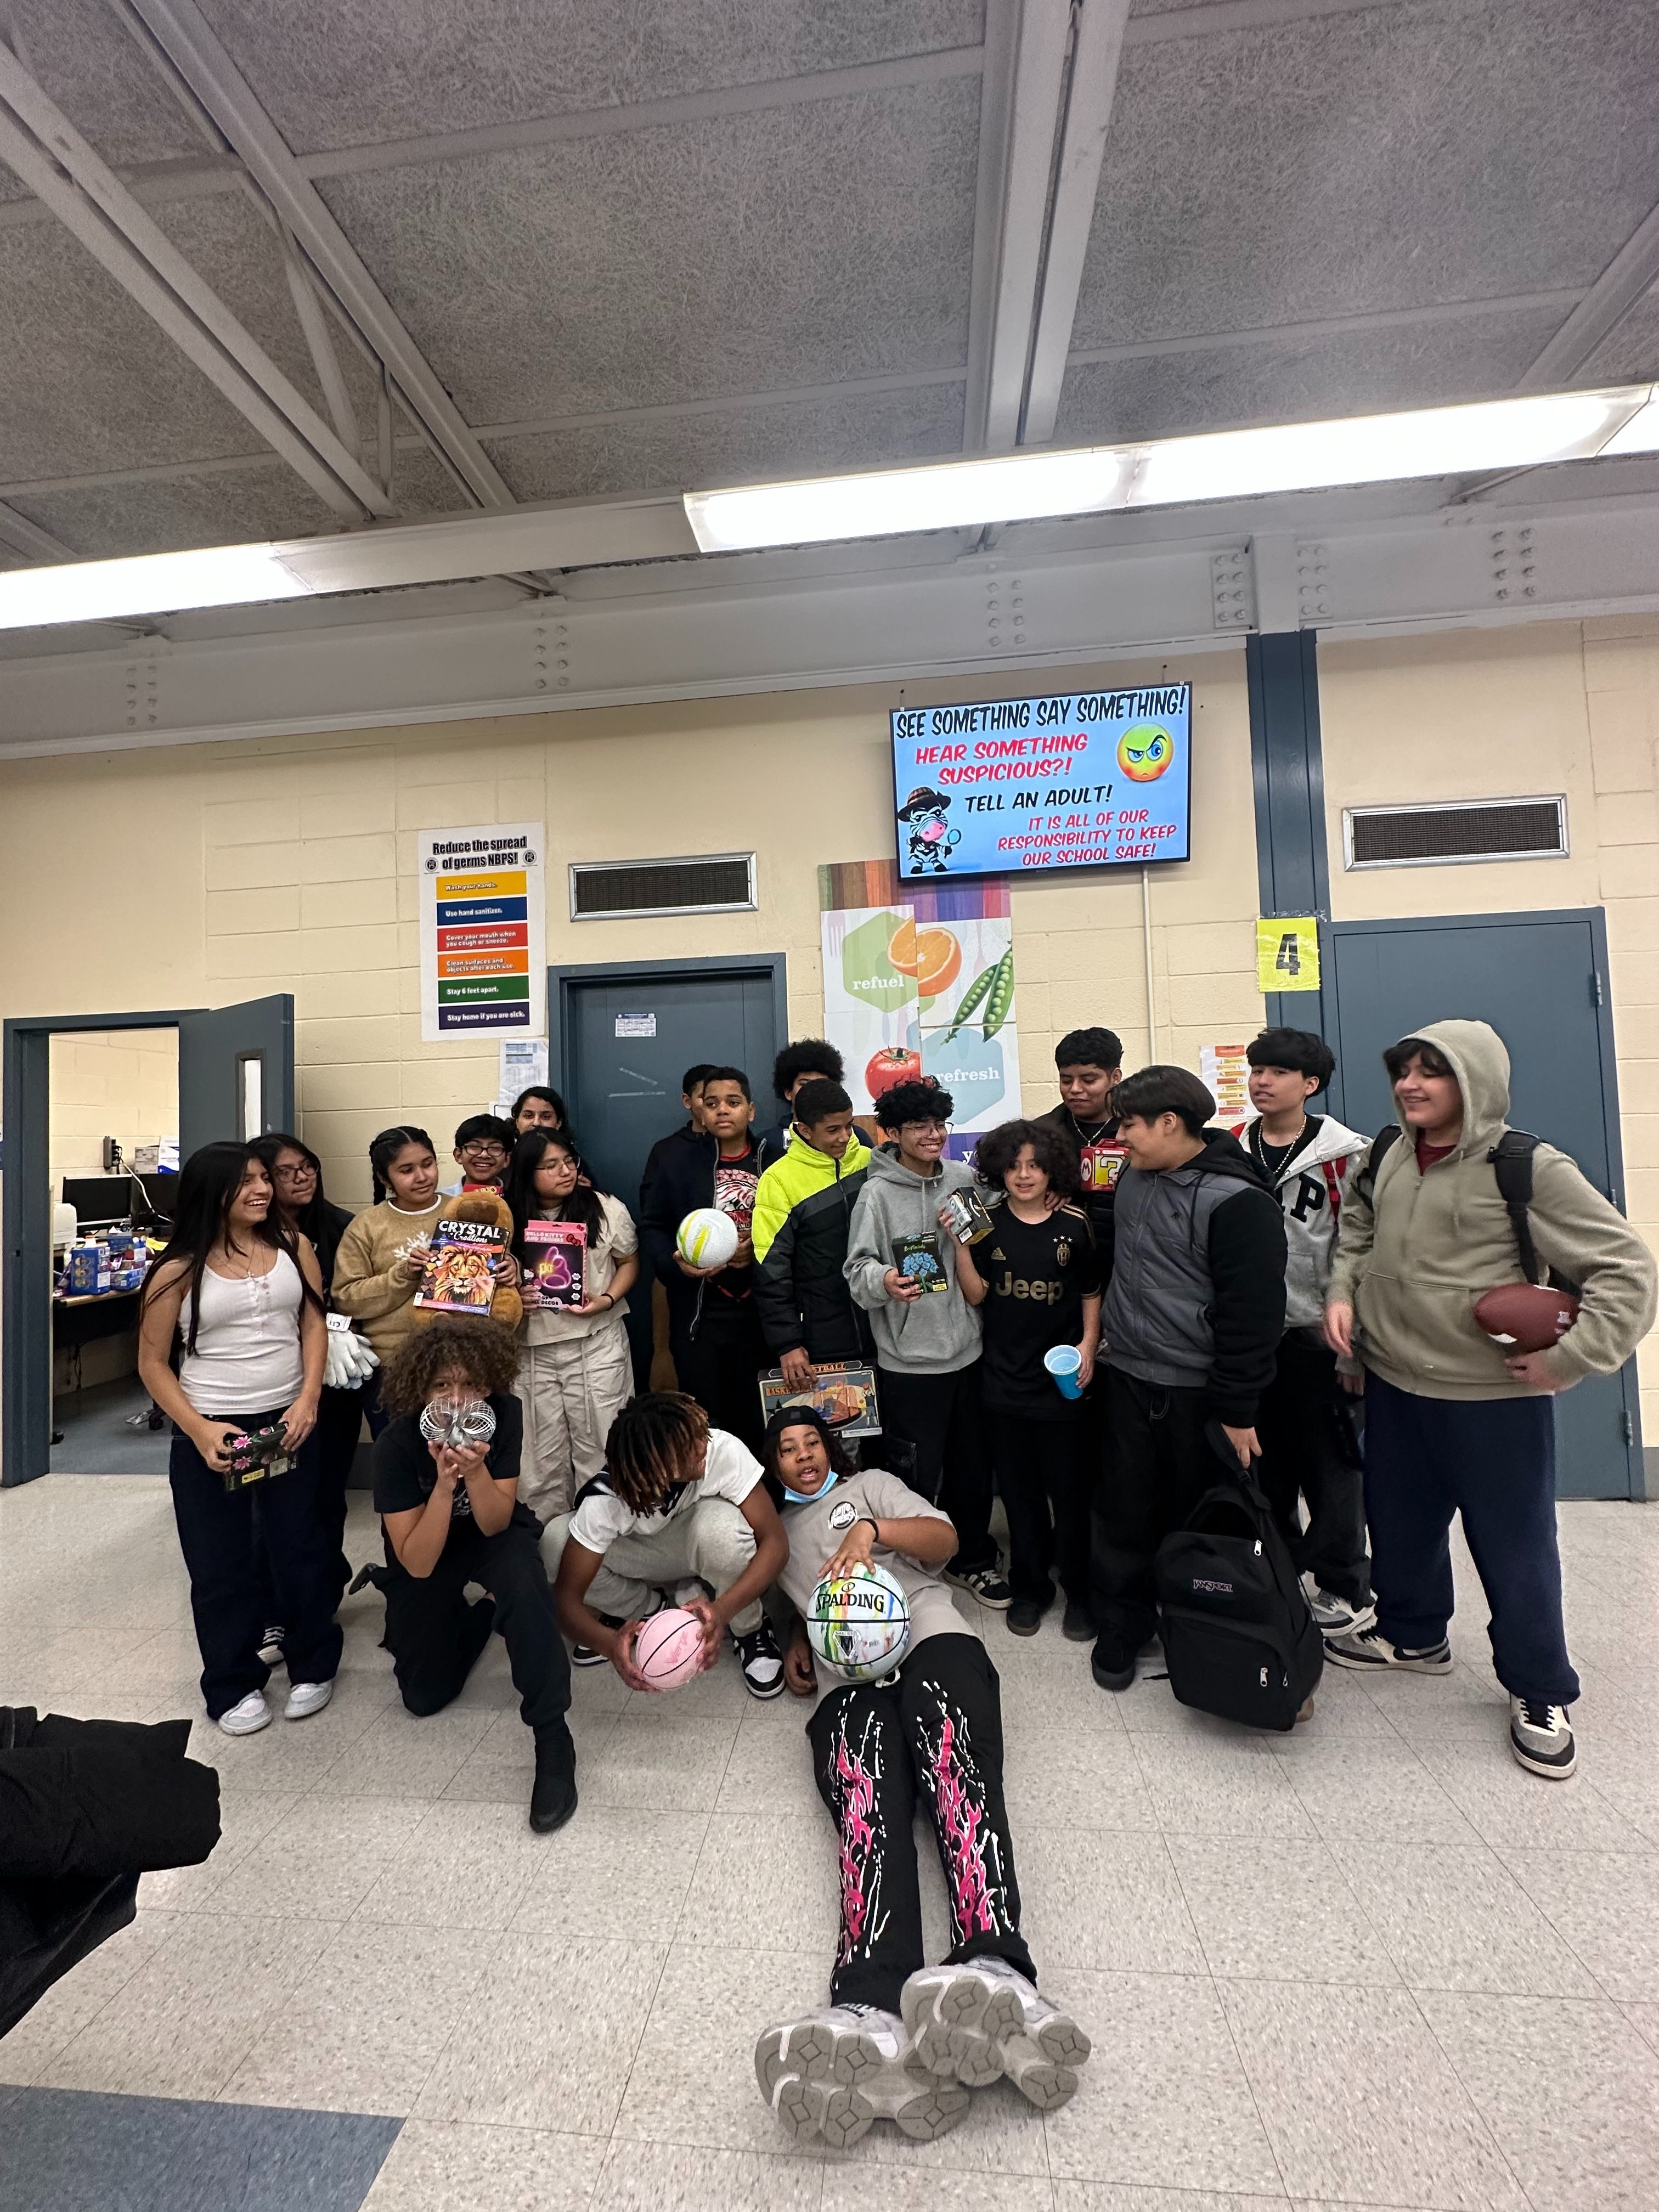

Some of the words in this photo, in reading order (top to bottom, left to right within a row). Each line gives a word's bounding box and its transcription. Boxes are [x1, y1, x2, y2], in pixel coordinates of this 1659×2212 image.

[896, 712, 927, 739] SEE
[932, 702, 1030, 736] SOMETHING
[1036, 698, 1071, 726] SAY
[1076, 686, 1186, 723] SOMETHING!
[916, 743, 968, 765] HEAR
[973, 733, 1088, 760] SOMETHING
[938, 757, 1073, 785] SUSPICIOUS?!
[964, 794, 1005, 813] TELL
[1012, 791, 1039, 809] AN
[1044, 784, 1113, 807] ADULT!
[1029, 817, 1043, 831] IT
[1047, 815, 1062, 830] IS
[1065, 813, 1090, 828] ALL
[1096, 811, 1115, 826] OF
[1119, 809, 1149, 824] OUR
[432, 841, 471, 855] Reduce
[472, 839, 489, 851] the
[490, 836, 527, 851] spread
[998, 829, 1112, 850] RESPONSIBILITY
[1115, 827, 1135, 842] TO
[1139, 824, 1177, 840] KEEP
[442, 856, 453, 870] of
[454, 856, 487, 870] germs
[488, 852, 518, 866] NBPS!
[1023, 851, 1052, 866] OUR
[1056, 847, 1109, 864] SCHOOL
[1115, 842, 1156, 859] SAFE!
[1276, 933, 1300, 975] 4
[481, 986, 499, 994] apart.
[852, 974, 905, 990] refuel
[934, 1067, 1000, 1082] refresh
[439, 1220, 500, 1239] CRYSTAL
[453, 1232, 488, 1243] Creations
[995, 1271, 1064, 1306] Jeep
[1193, 1579, 1233, 1593] JANSPORT
[815, 1593, 885, 1613] SPALDING
